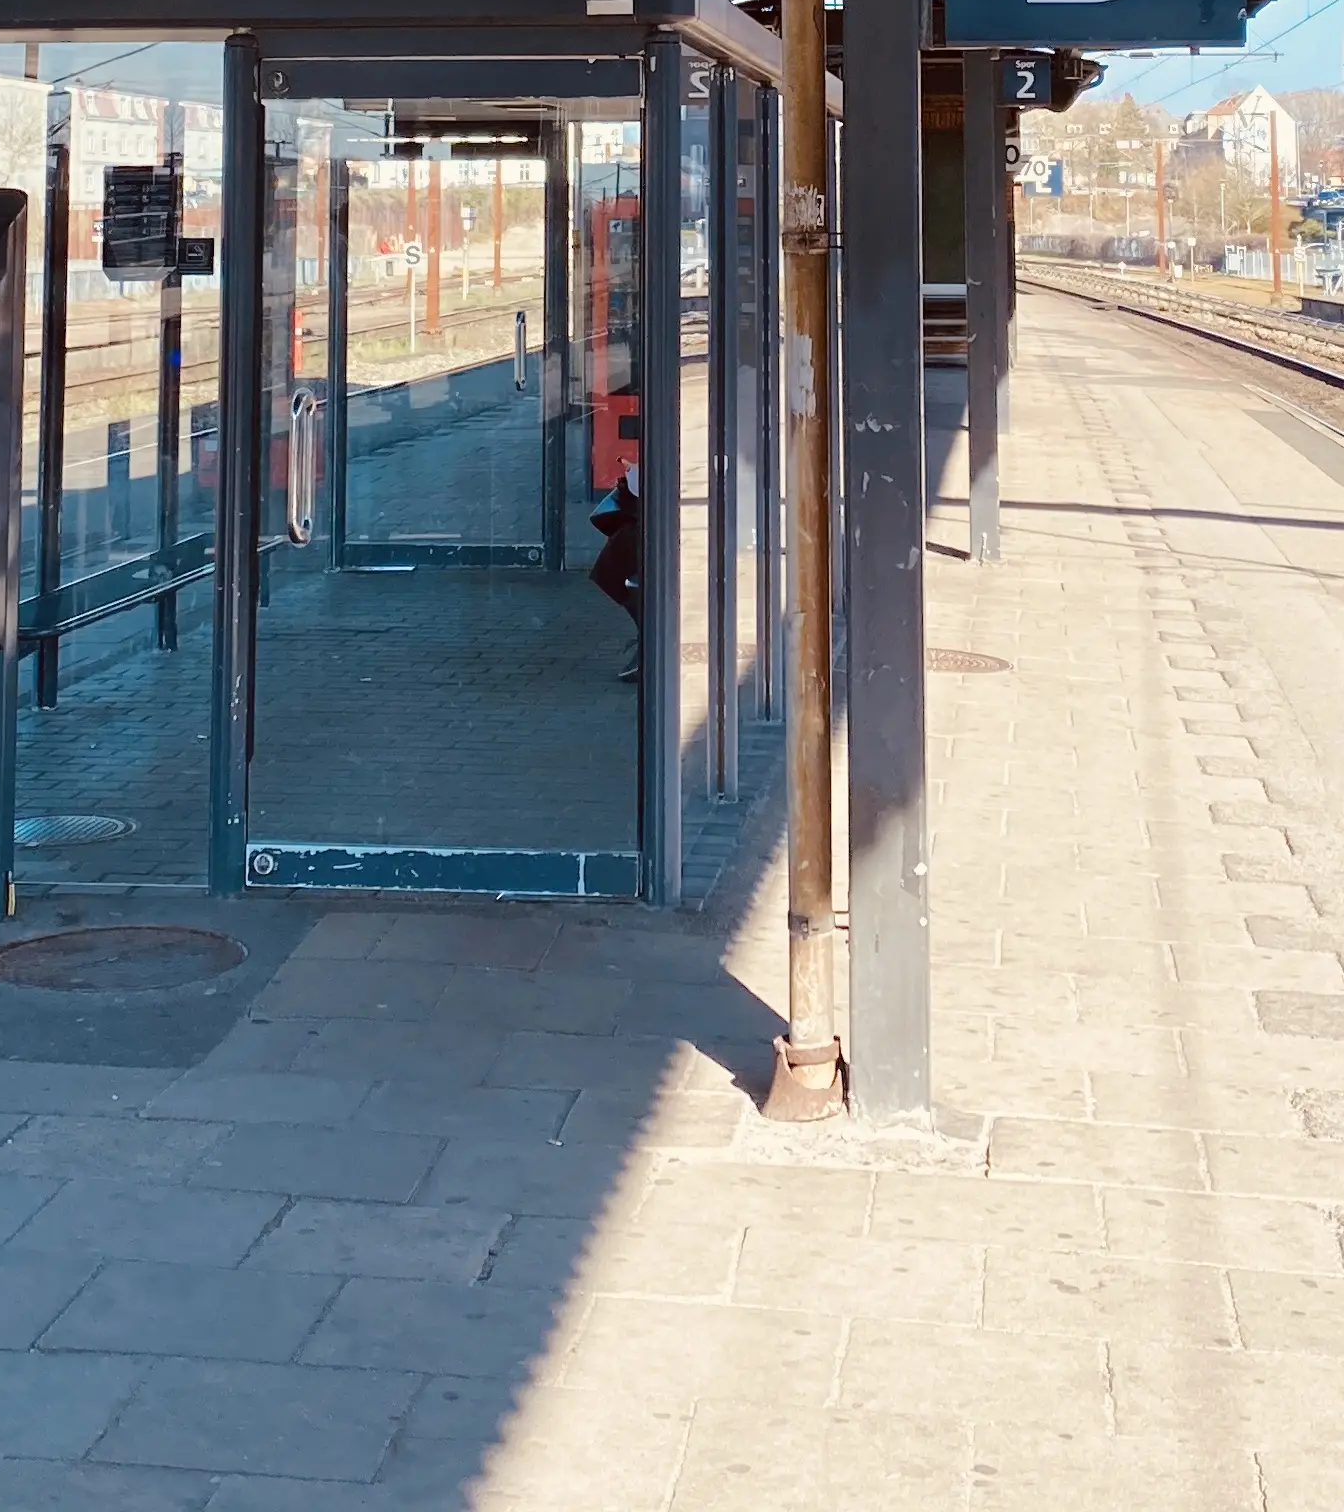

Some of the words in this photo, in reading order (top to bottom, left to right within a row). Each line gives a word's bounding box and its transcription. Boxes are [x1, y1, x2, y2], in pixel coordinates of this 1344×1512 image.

[1016, 60, 1036, 69] Spor
[1016, 70, 1036, 99] 2
[406, 245, 420, 264] S
